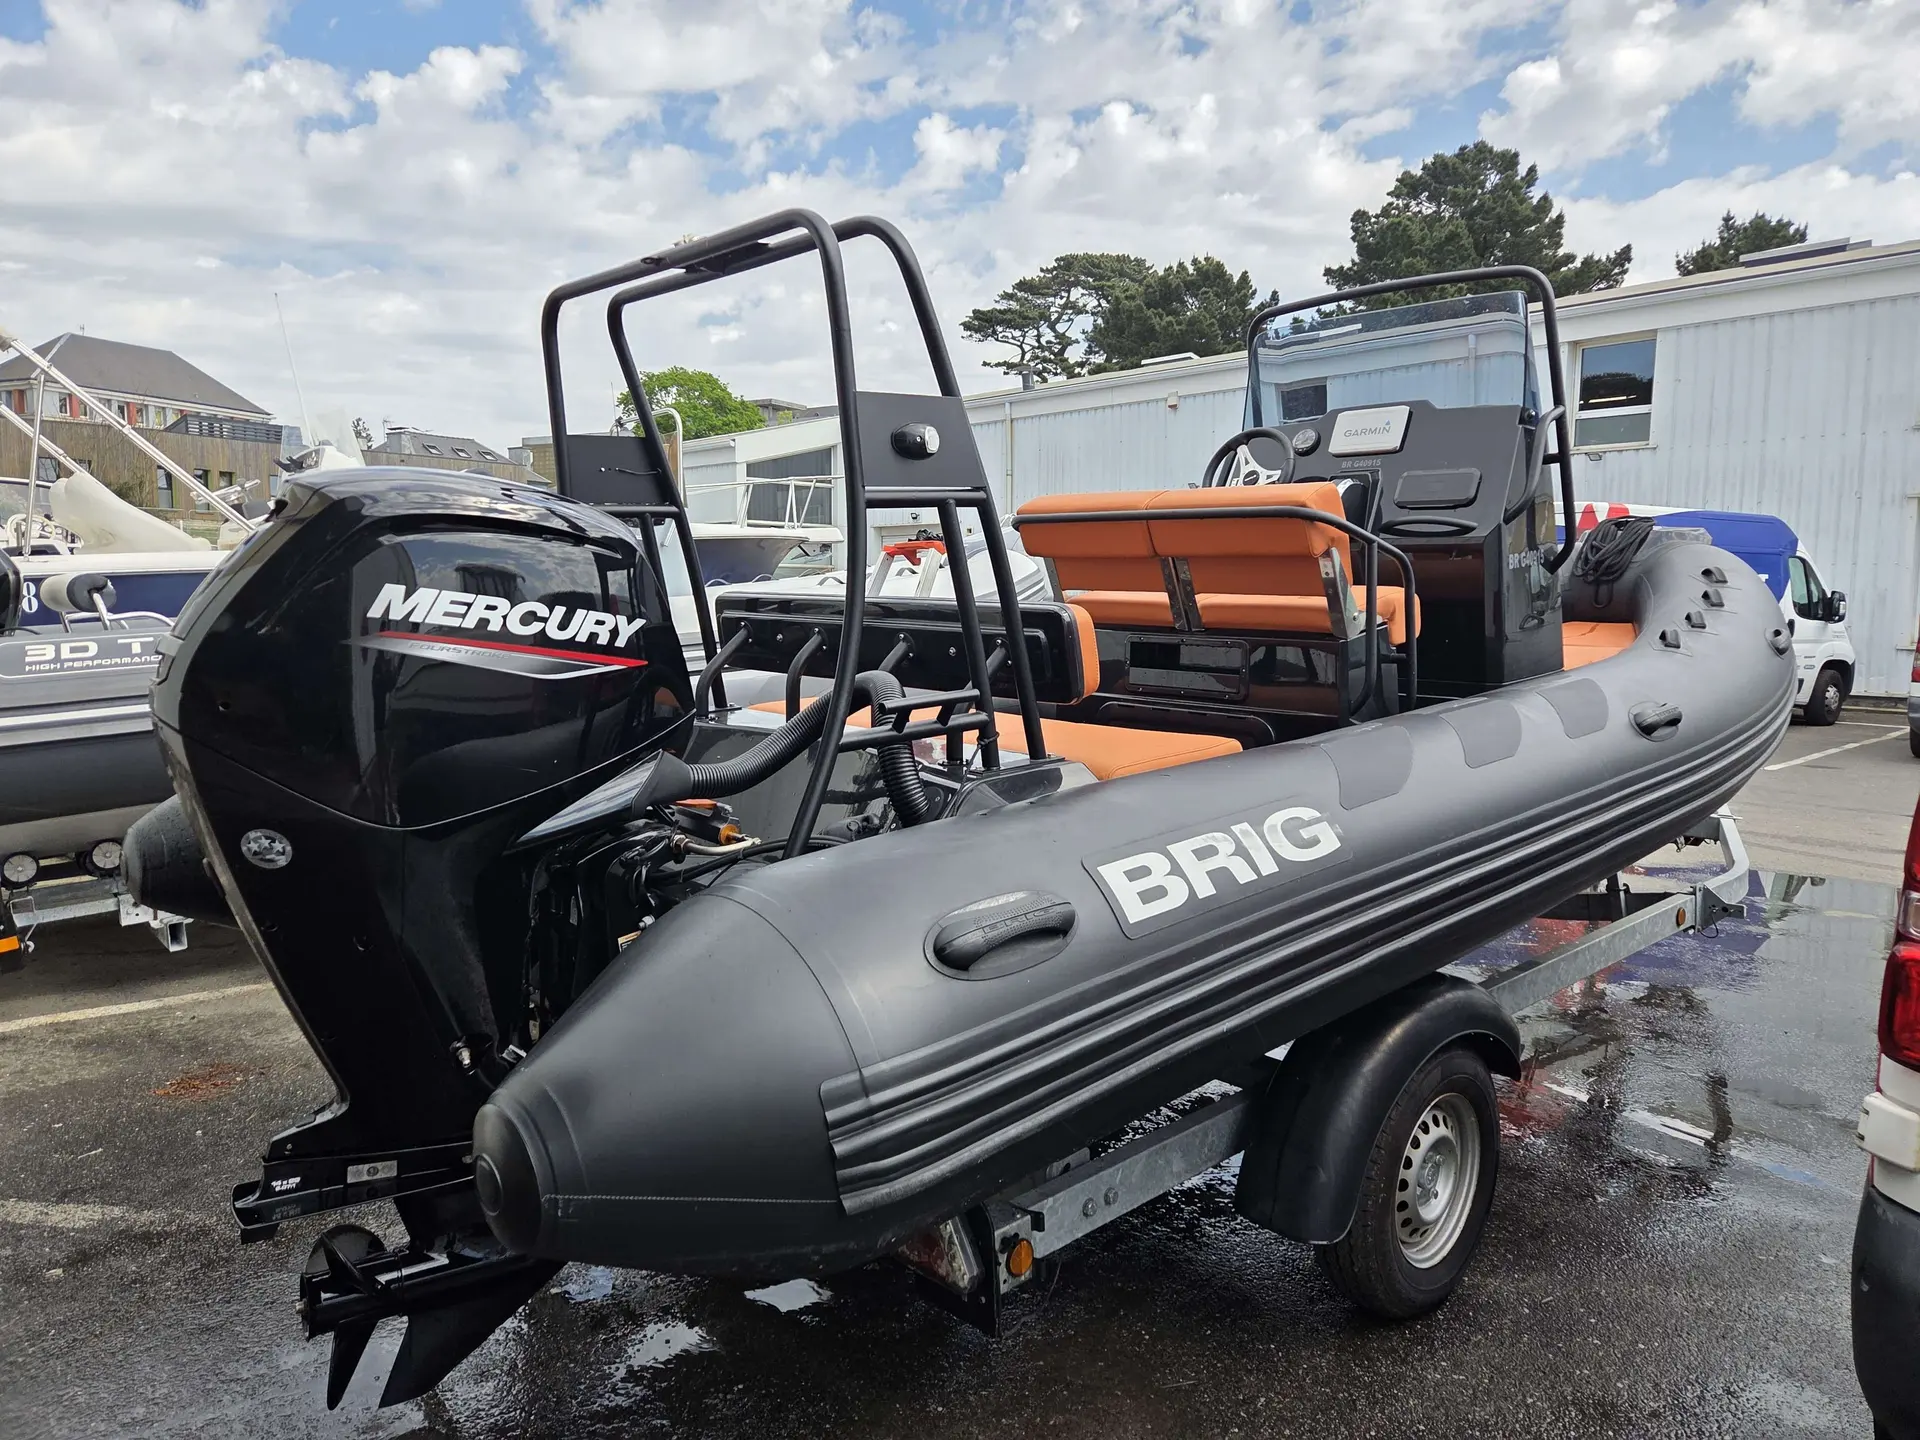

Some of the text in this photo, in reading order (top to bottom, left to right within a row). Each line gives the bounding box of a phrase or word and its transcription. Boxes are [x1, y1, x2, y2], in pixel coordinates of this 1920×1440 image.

[1343, 424, 1391, 438] GARMIN
[1341, 460, 1353, 469] BR
[1508, 553, 1520, 570] BR
[366, 583, 647, 648] MERCURY
[25, 641, 98, 662] 3D
[25, 663, 61, 672] HIGH
[1097, 806, 1342, 924] BRIG
